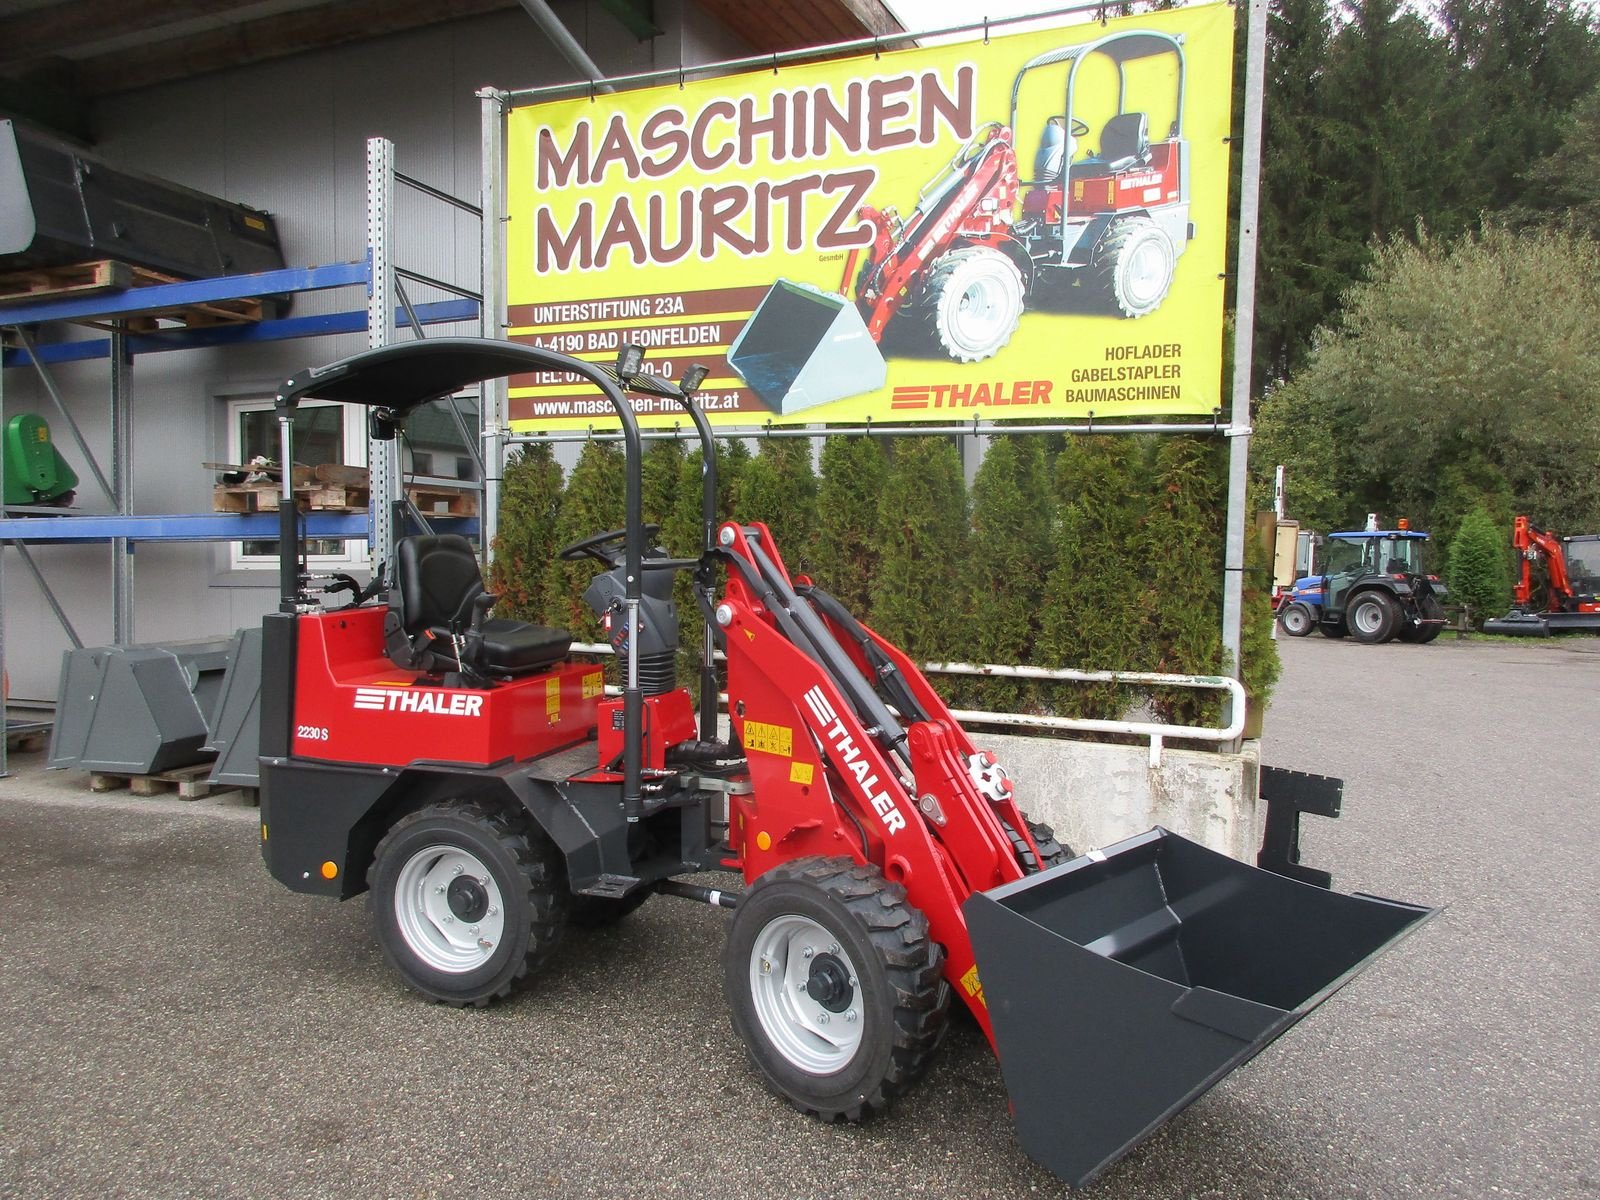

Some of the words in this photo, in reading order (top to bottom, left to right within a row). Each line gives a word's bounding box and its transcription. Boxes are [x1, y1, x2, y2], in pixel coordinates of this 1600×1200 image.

[537, 66, 974, 190] MASCHINEN
[537, 169, 876, 273] MAURITZ
[534, 299, 650, 324] UNTERSTIFTUNG
[654, 296, 685, 315] 23A
[588, 332, 618, 350] BAD
[1105, 343, 1182, 361] HOFLADER
[1071, 364, 1182, 383] GABELSTAPLER
[931, 380, 1053, 408] THALER
[1065, 385, 1181, 403] BAUMASCHINEN
[386, 688, 484, 717] THALER
[298, 725, 320, 740] 2230
[321, 728, 329, 741] S
[827, 717, 906, 836] THALER
